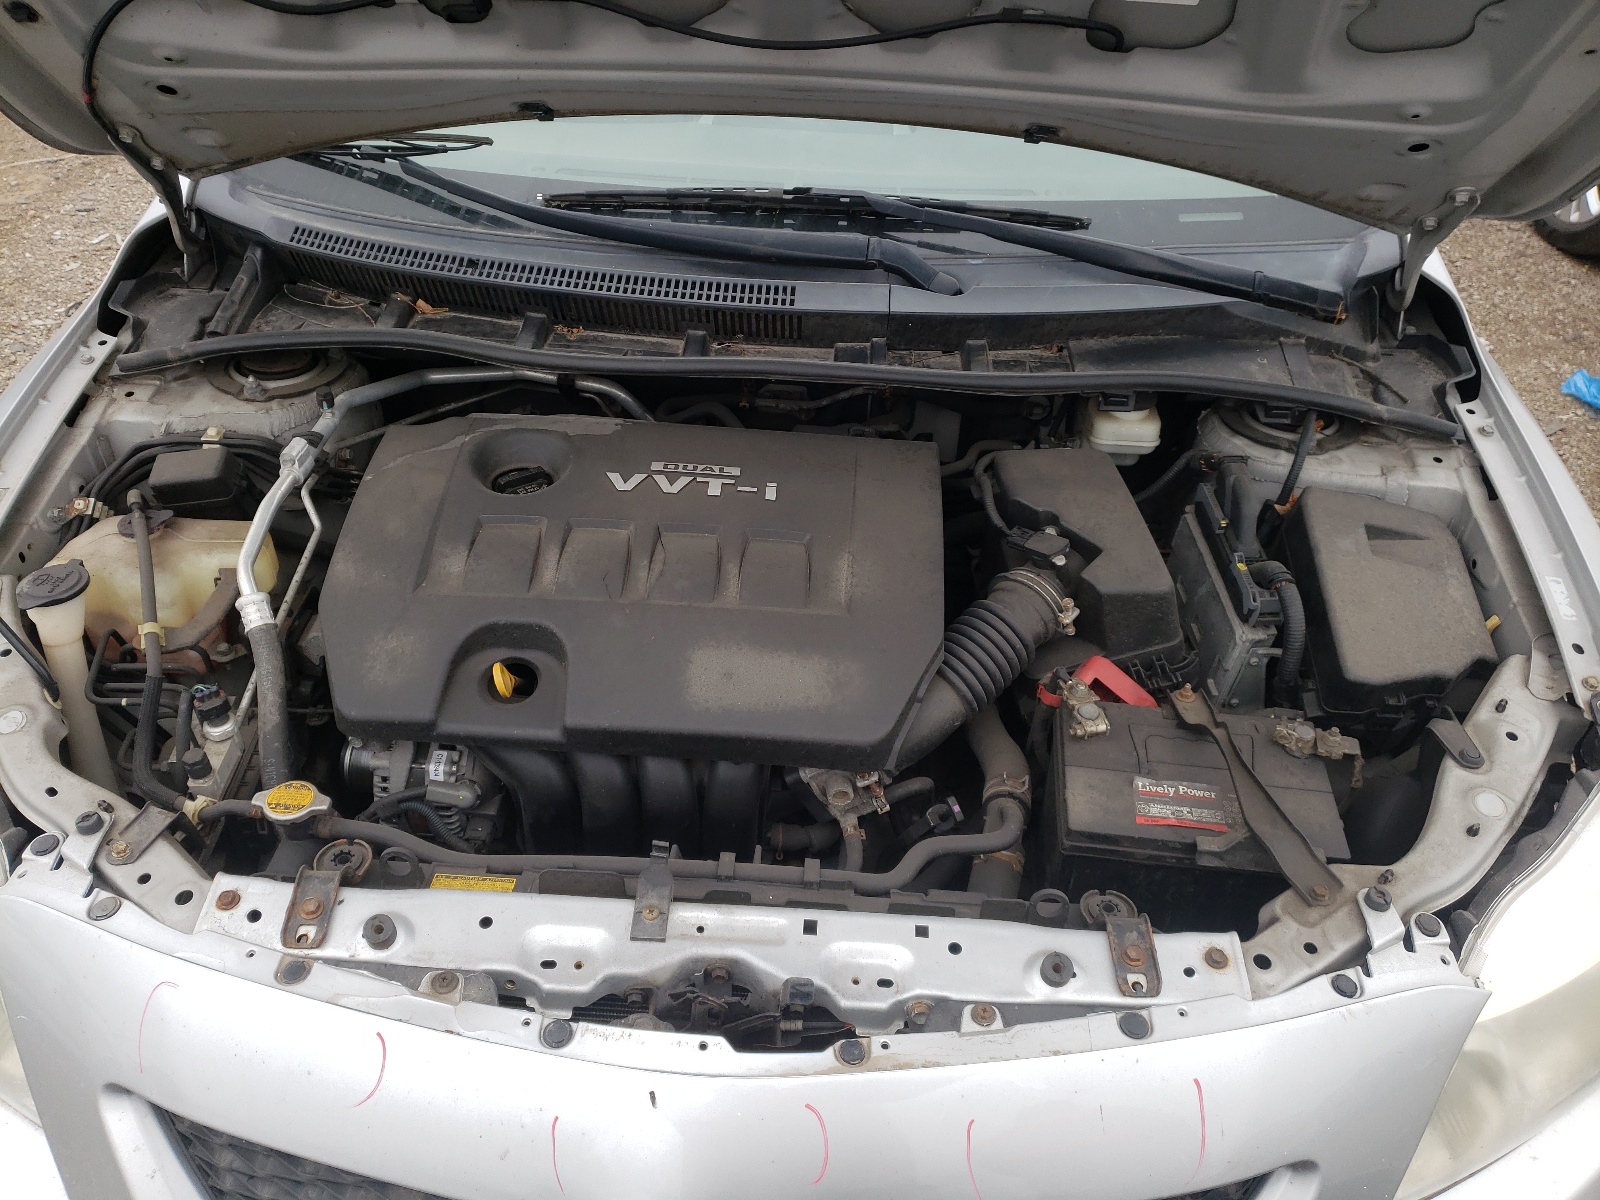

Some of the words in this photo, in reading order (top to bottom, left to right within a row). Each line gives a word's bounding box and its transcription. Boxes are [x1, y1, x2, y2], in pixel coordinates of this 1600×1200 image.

[662, 462, 734, 475] DUAL
[605, 471, 778, 501] VVT-i
[1137, 781, 1176, 797] Lively
[1178, 785, 1217, 799] Power
